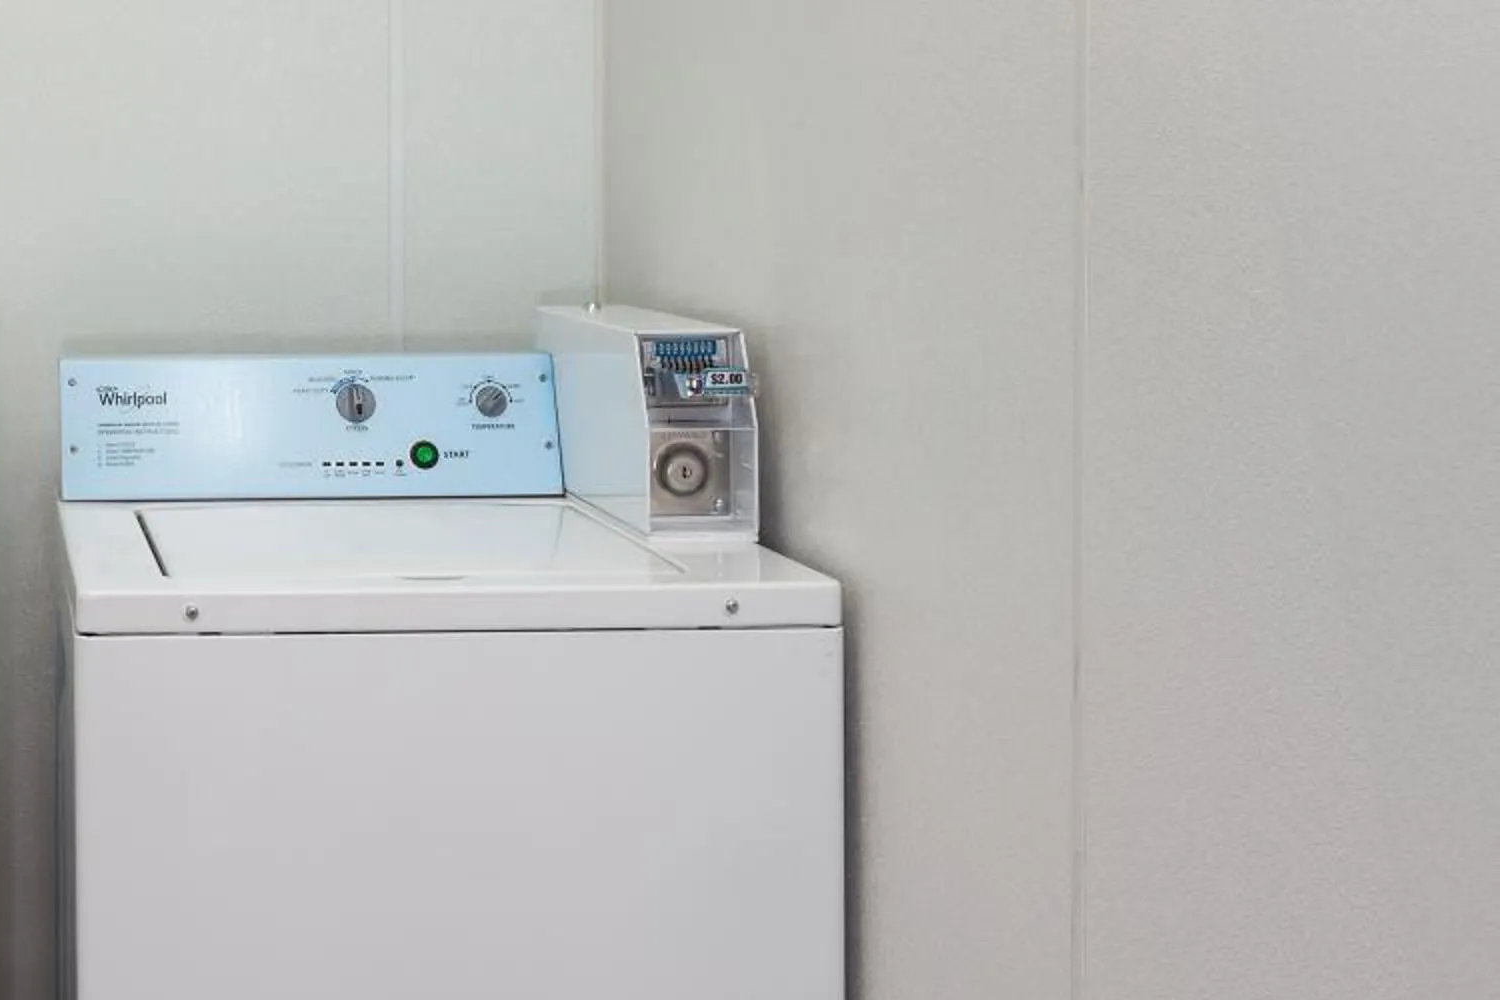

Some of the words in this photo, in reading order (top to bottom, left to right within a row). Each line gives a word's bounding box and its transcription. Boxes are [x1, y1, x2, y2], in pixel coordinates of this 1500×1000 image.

[710, 373, 743, 385] $2.00
[99, 391, 167, 409] Whirlpool
[443, 450, 469, 459] START
